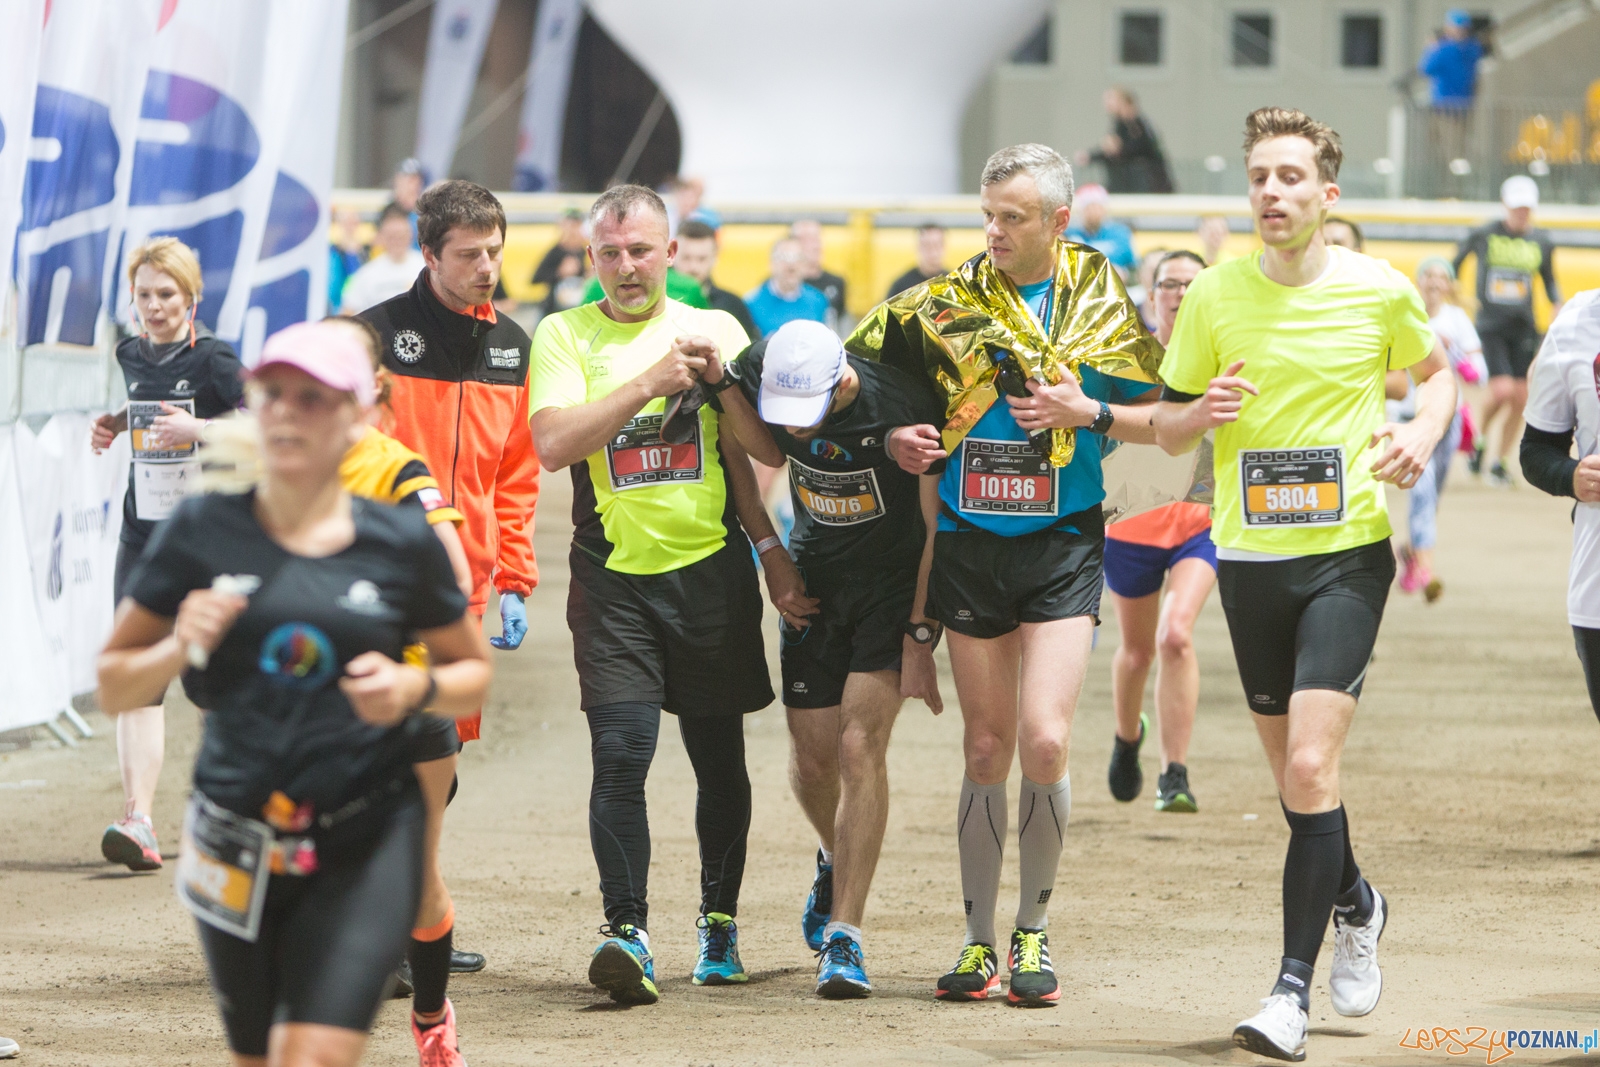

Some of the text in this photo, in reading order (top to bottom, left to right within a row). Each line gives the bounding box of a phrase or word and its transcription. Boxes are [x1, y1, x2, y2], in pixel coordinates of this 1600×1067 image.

[639, 447, 672, 470] 107
[979, 476, 1036, 500] 10136
[1265, 486, 1319, 511] 5804
[807, 492, 862, 514] 10076
